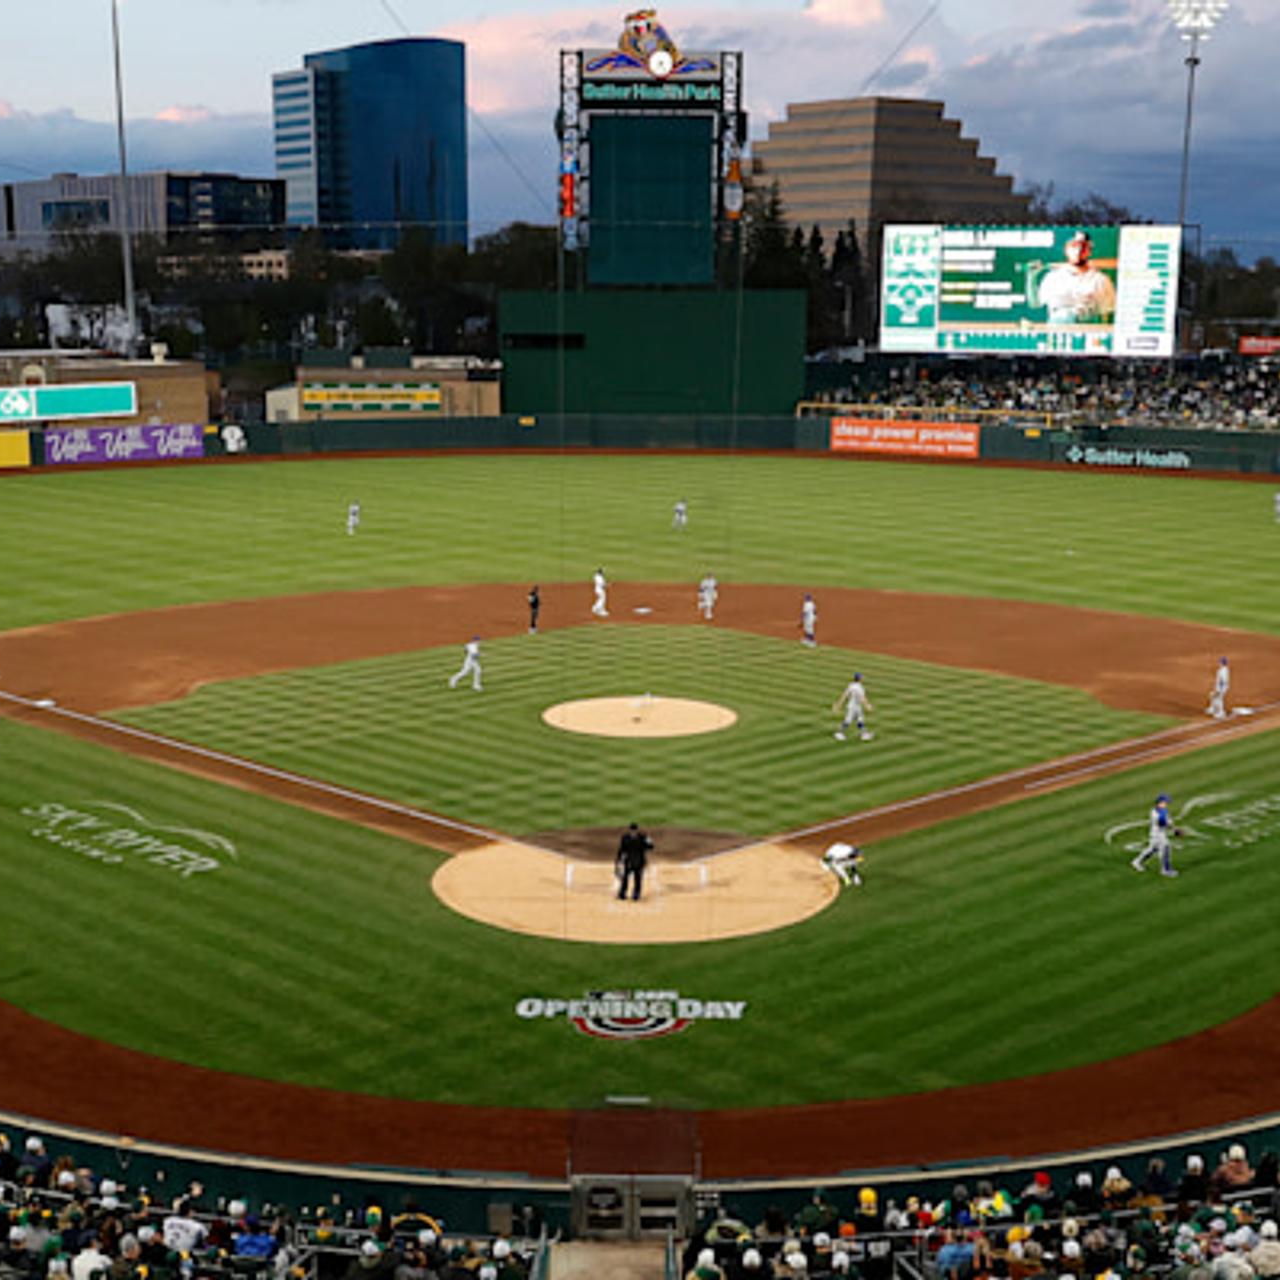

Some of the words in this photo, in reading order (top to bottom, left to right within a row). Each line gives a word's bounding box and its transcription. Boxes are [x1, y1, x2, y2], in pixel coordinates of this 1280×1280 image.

[633, 83, 682, 100] Health
[685, 83, 721, 100] Park
[1084, 447, 1134, 465] Sutter
[1136, 449, 1190, 468] Health
[91, 829, 220, 880] RIVER
[516, 998, 671, 1019] OPENING
[677, 999, 747, 1019] DAY
